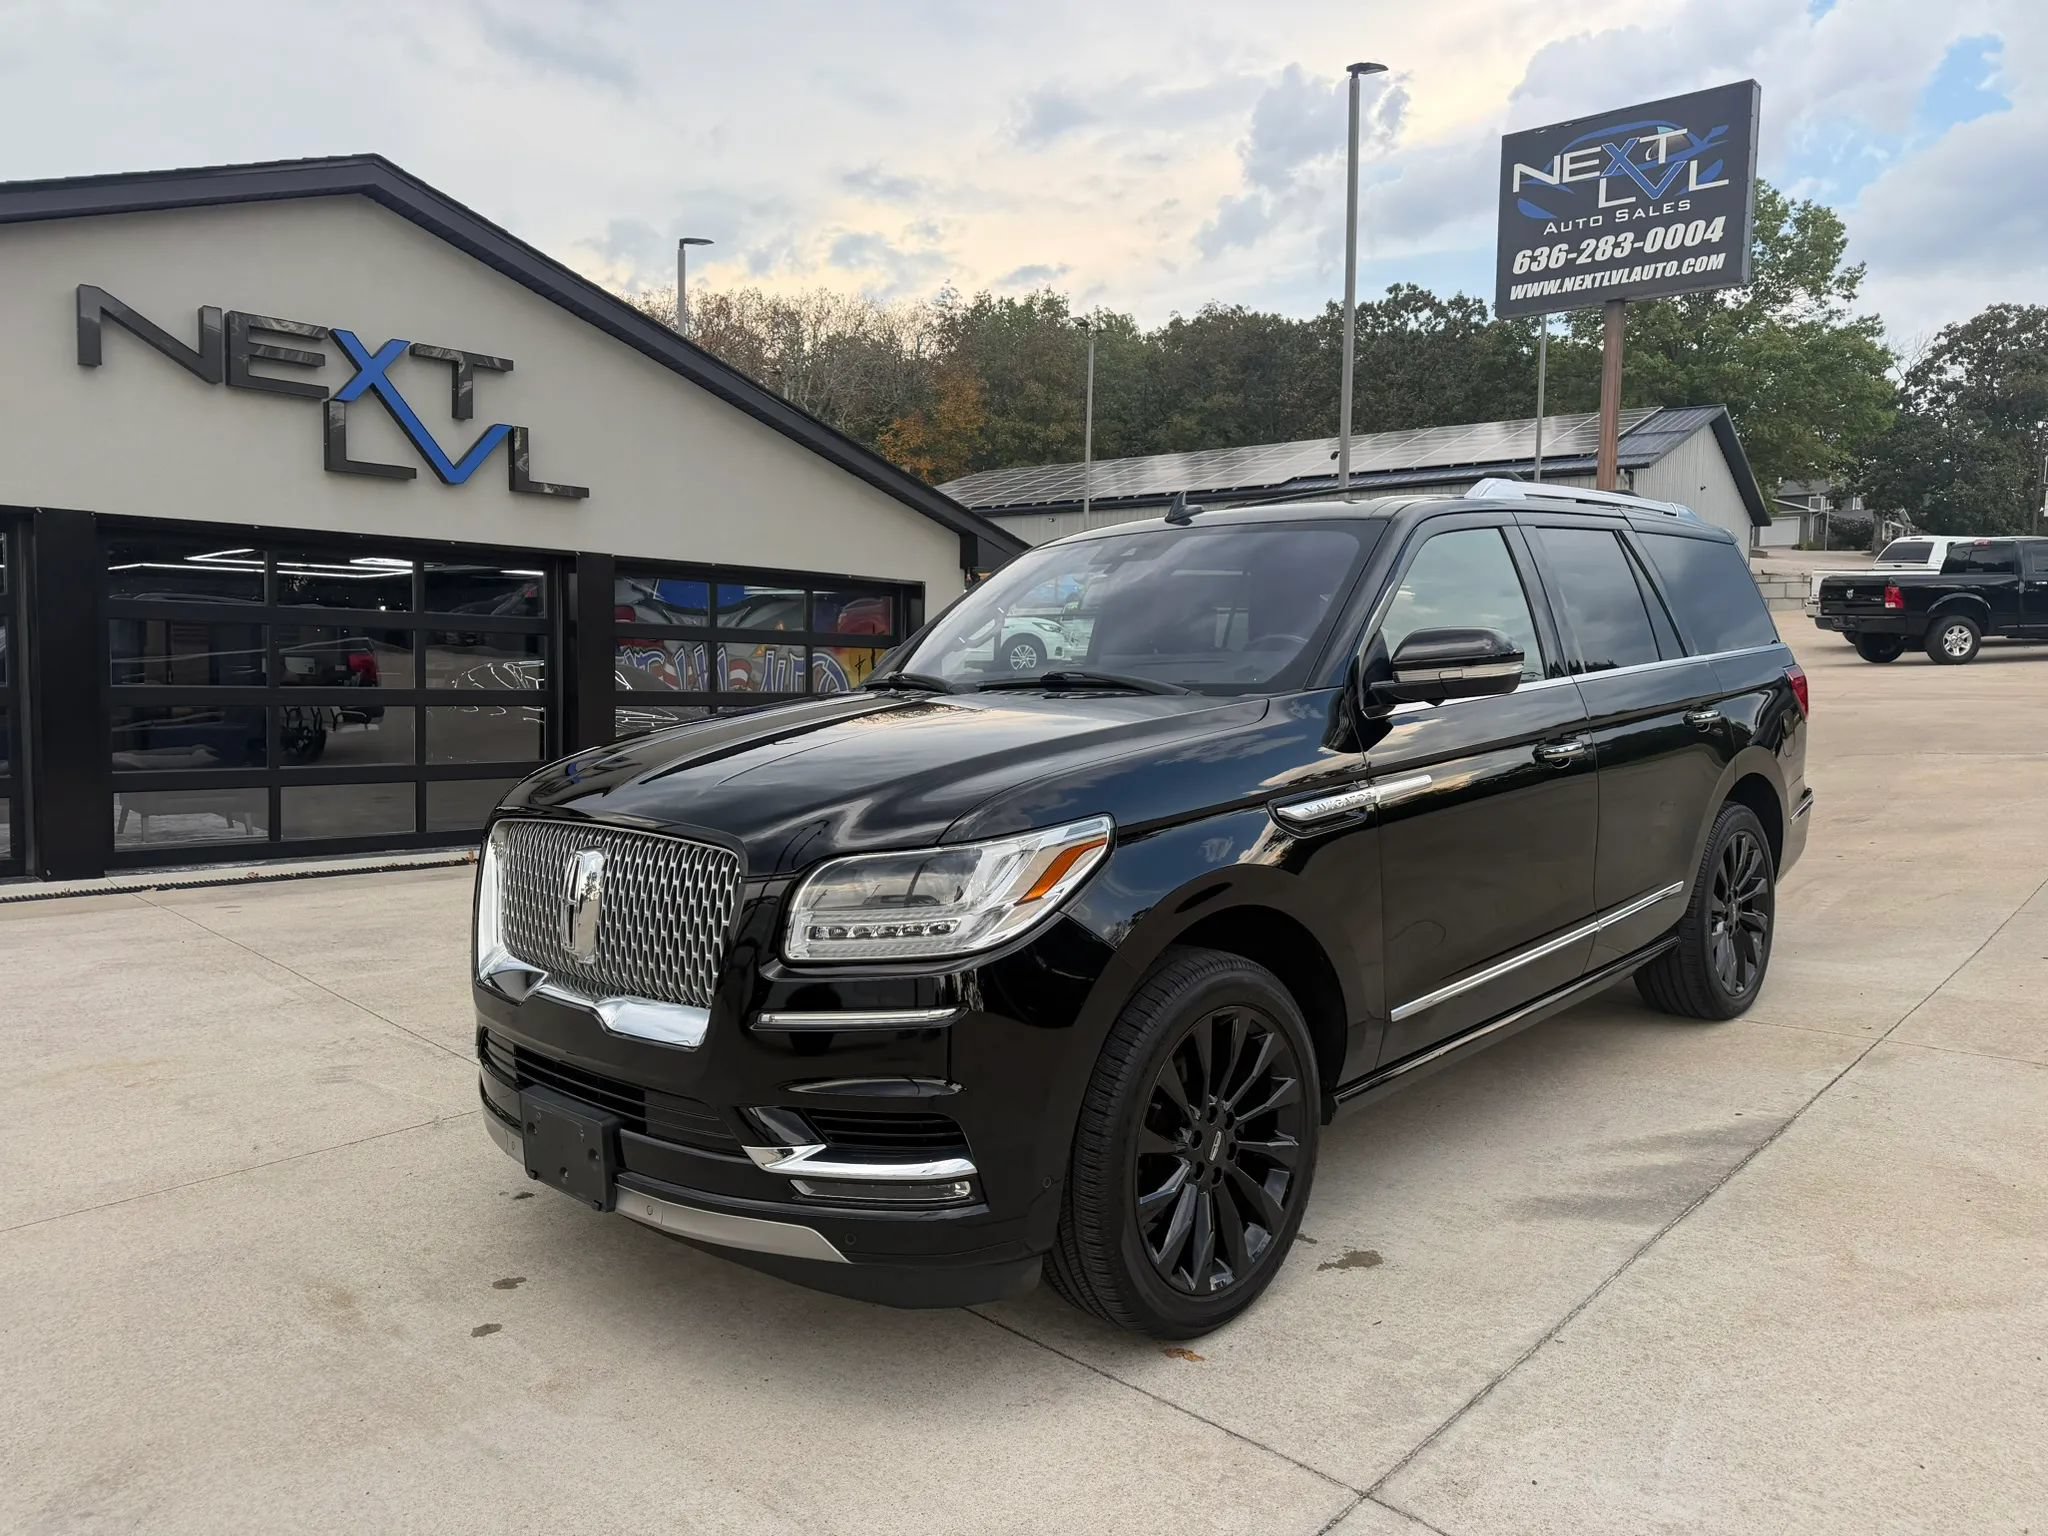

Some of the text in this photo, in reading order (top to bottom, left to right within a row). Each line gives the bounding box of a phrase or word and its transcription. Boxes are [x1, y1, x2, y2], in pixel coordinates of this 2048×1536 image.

[1512, 128, 1688, 193] NEXT
[1598, 159, 1730, 208] LVL
[1512, 216, 1726, 275] 636-283-0004
[1543, 199, 1691, 235] AUTO SALES
[1509, 253, 1726, 301] WWW.NEXTLVLAUTO.COM
[76, 283, 514, 419] NEXT
[323, 399, 590, 499] LVL
